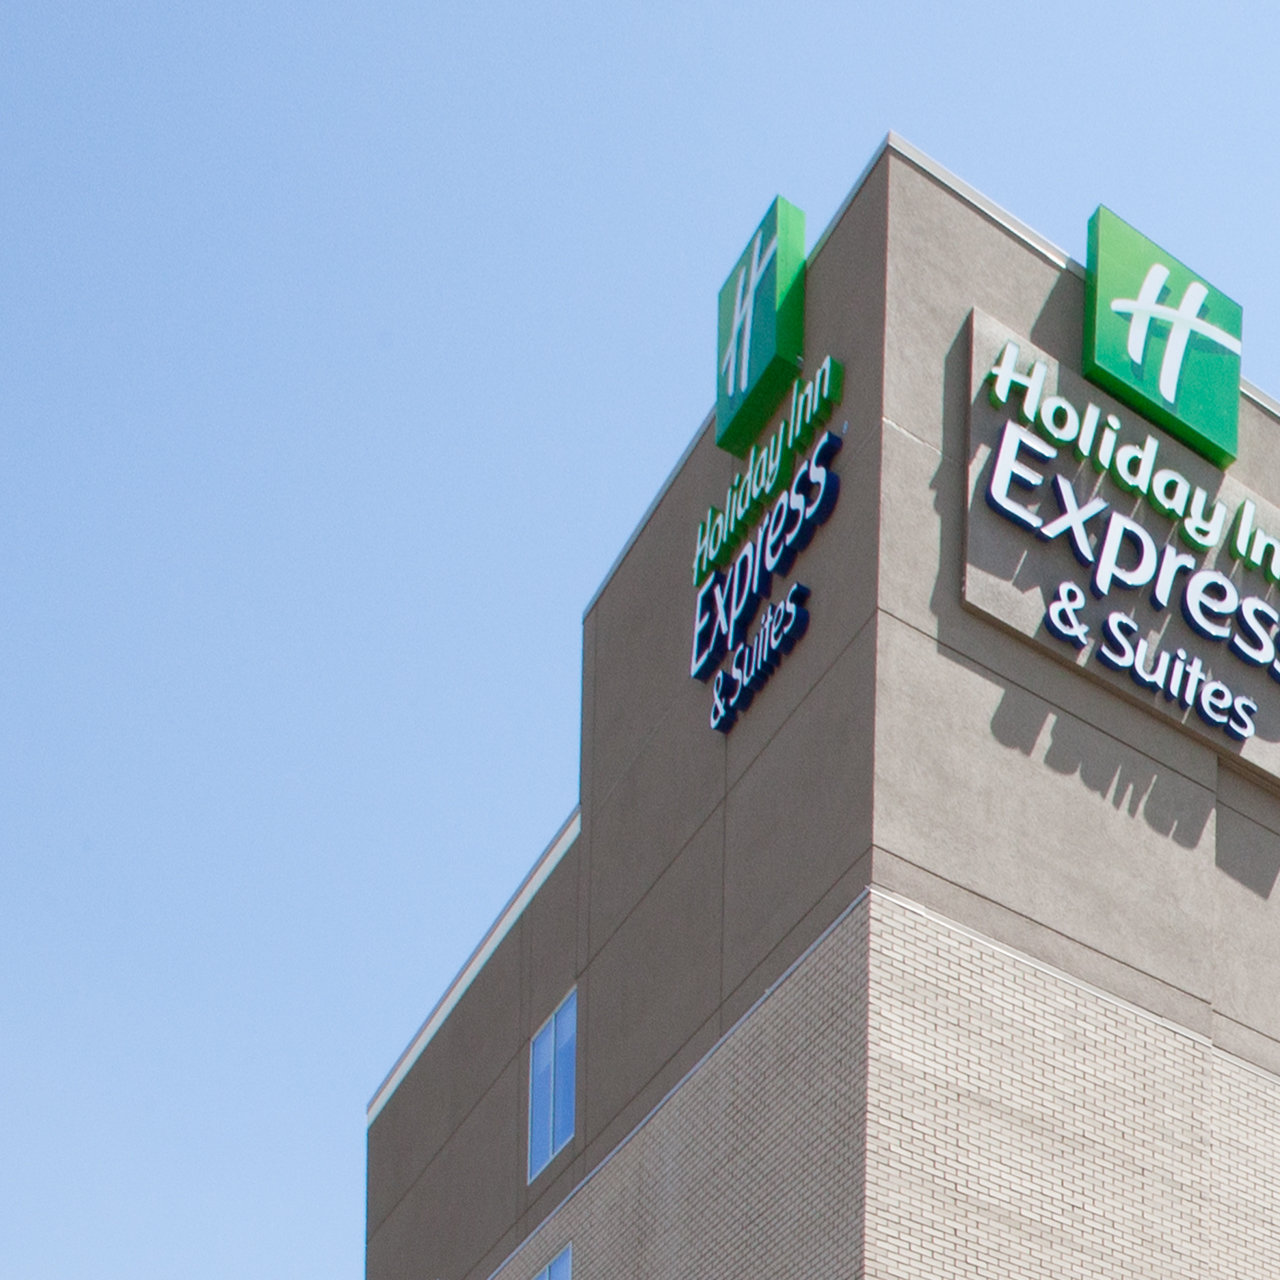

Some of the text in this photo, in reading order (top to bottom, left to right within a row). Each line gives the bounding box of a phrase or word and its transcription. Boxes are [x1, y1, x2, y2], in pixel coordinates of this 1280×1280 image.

[693, 355, 834, 587] Holiday Inn
[989, 340, 1229, 550] Holiday
[690, 430, 834, 681] Express
[709, 581, 802, 731] & Suites
[1047, 579, 1260, 741] & Suites
